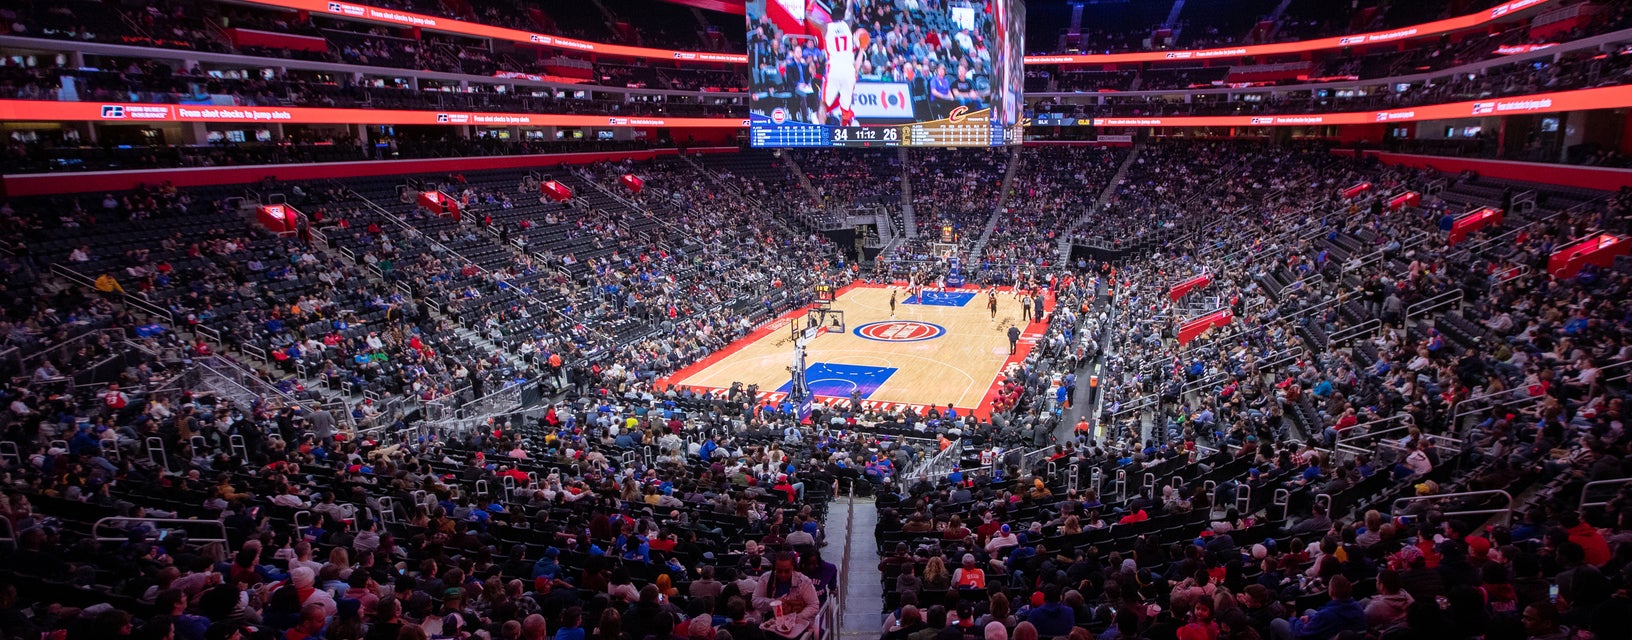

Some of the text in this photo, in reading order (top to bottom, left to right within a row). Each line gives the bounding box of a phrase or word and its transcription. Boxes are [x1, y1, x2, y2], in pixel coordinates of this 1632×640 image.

[835, 36, 847, 52] 17
[180, 108, 291, 120] From shot clocks to jump shots
[834, 129, 848, 140] 34
[856, 131, 875, 139] 11:12
[884, 128, 897, 140] 26
